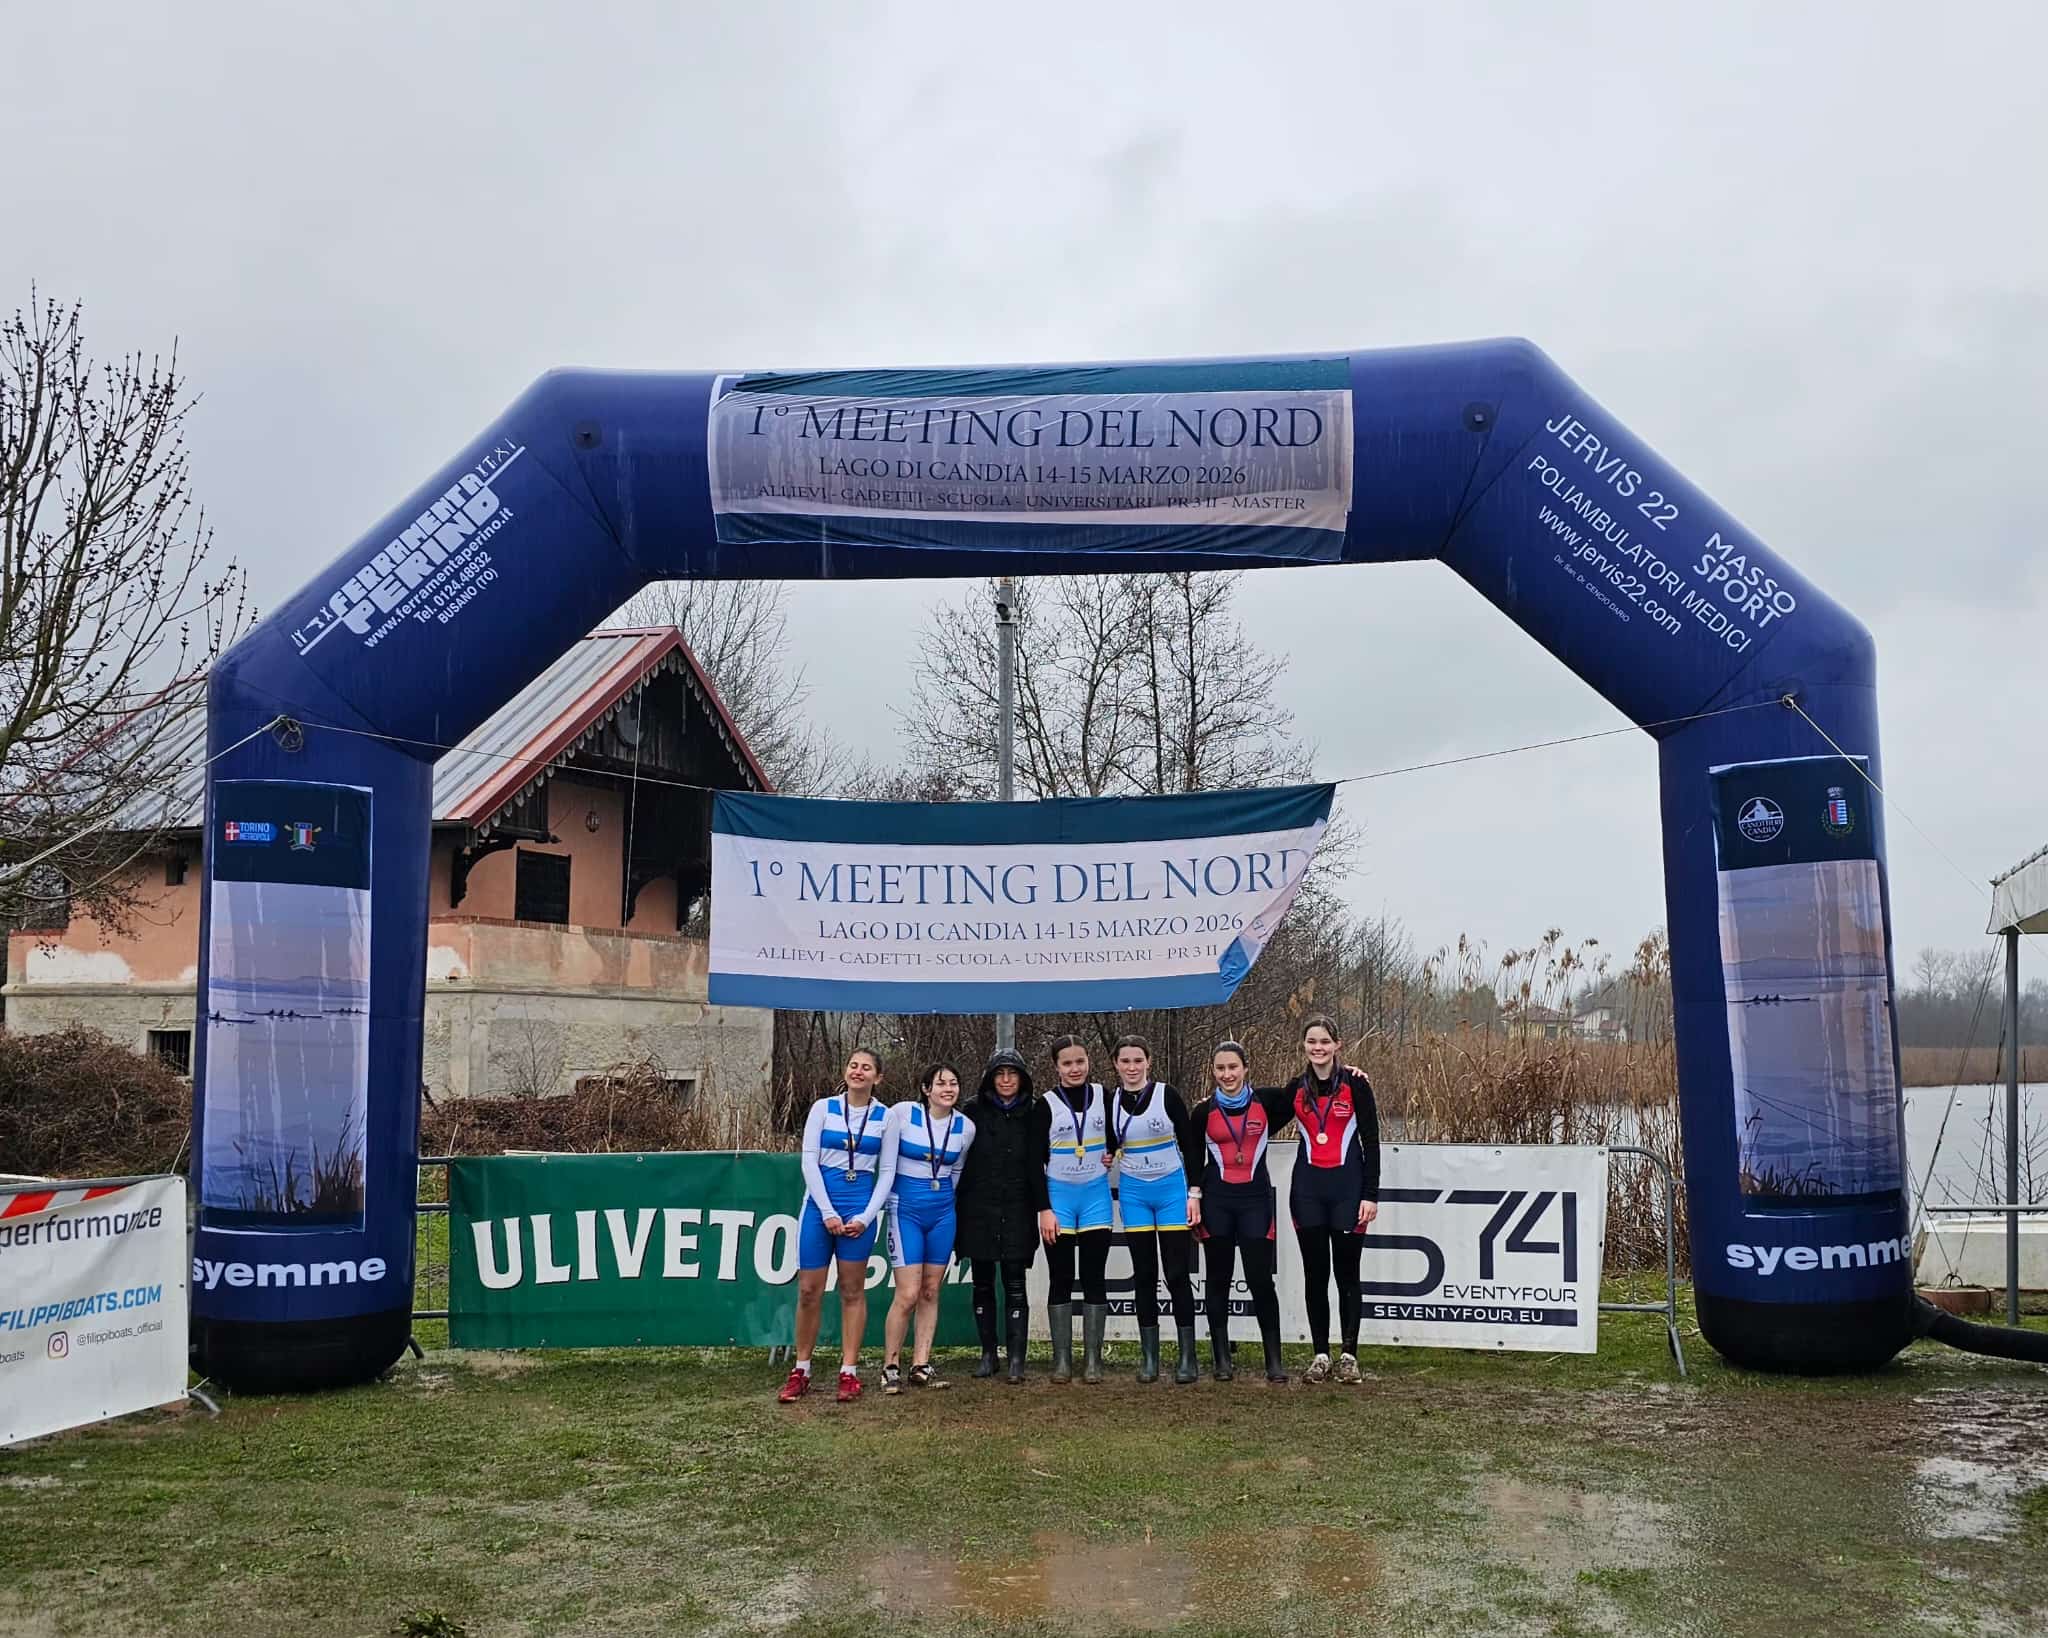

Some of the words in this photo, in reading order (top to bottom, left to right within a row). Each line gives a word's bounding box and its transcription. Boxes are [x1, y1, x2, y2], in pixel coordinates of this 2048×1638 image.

[797, 405, 1042, 448] MEETING
[1056, 408, 1155, 448] DEL
[1167, 406, 1323, 448] NORD
[819, 456, 889, 479] LAGO
[896, 459, 922, 480] DI
[928, 461, 1029, 483] CANDIA
[1036, 465, 1092, 485] 14-15
[1099, 465, 1190, 486] MARZO
[1197, 466, 1247, 486] 2026
[1545, 414, 1643, 498] JERVIS
[1637, 491, 1680, 532] 22
[841, 487, 923, 503] CADETTI
[937, 491, 1012, 507] SCUOLA
[1026, 494, 1153, 509] UNIVERSITARI
[1231, 496, 1306, 510] MASTER
[329, 472, 485, 617] FERRAMENTA
[342, 486, 500, 635] PERINO
[1528, 455, 1686, 598] POLIAMBULATORI
[1681, 589, 1753, 654] MEDICI
[364, 506, 514, 649] www.ferramentaperino.it
[413, 604, 437, 625] Tel.
[432, 550, 493, 608] 0124.48932
[1538, 505, 1683, 636] www.jervis22.com
[1692, 553, 1782, 630] SPORT
[1704, 531, 1797, 615] MASSO
[436, 585, 479, 625] BUSANO
[474, 567, 499, 591] (TO)
[240, 822, 270, 833] TORINO
[796, 861, 1040, 905] MEETING
[1052, 861, 1150, 904] DEL
[817, 920, 889, 941] LAGO
[895, 922, 921, 941] DI
[927, 922, 1028, 942] CANDIA
[1035, 920, 1091, 940] 14-15
[1096, 916, 1188, 939] MARZO
[1194, 911, 1244, 933] 2026
[756, 946, 825, 963] ALLIEVI
[839, 951, 922, 966] CADETTI
[936, 952, 1012, 966] SCUOLA
[1025, 949, 1153, 966] UNIVERSITARI
[0, 1207, 162, 1254] performance
[471, 1208, 800, 1290] ULIVETO
[192, 1256, 387, 1290] syemme
[1726, 1234, 1912, 1276] syemme
[0, 1283, 162, 1331] FILIPPIBOATS.COM
[1373, 1305, 1544, 1322] SEVENTYFOUR.EU
[1443, 1284, 1577, 1302] EVENTYFOUR
[76, 1319, 163, 1347] @filippiboats_official
